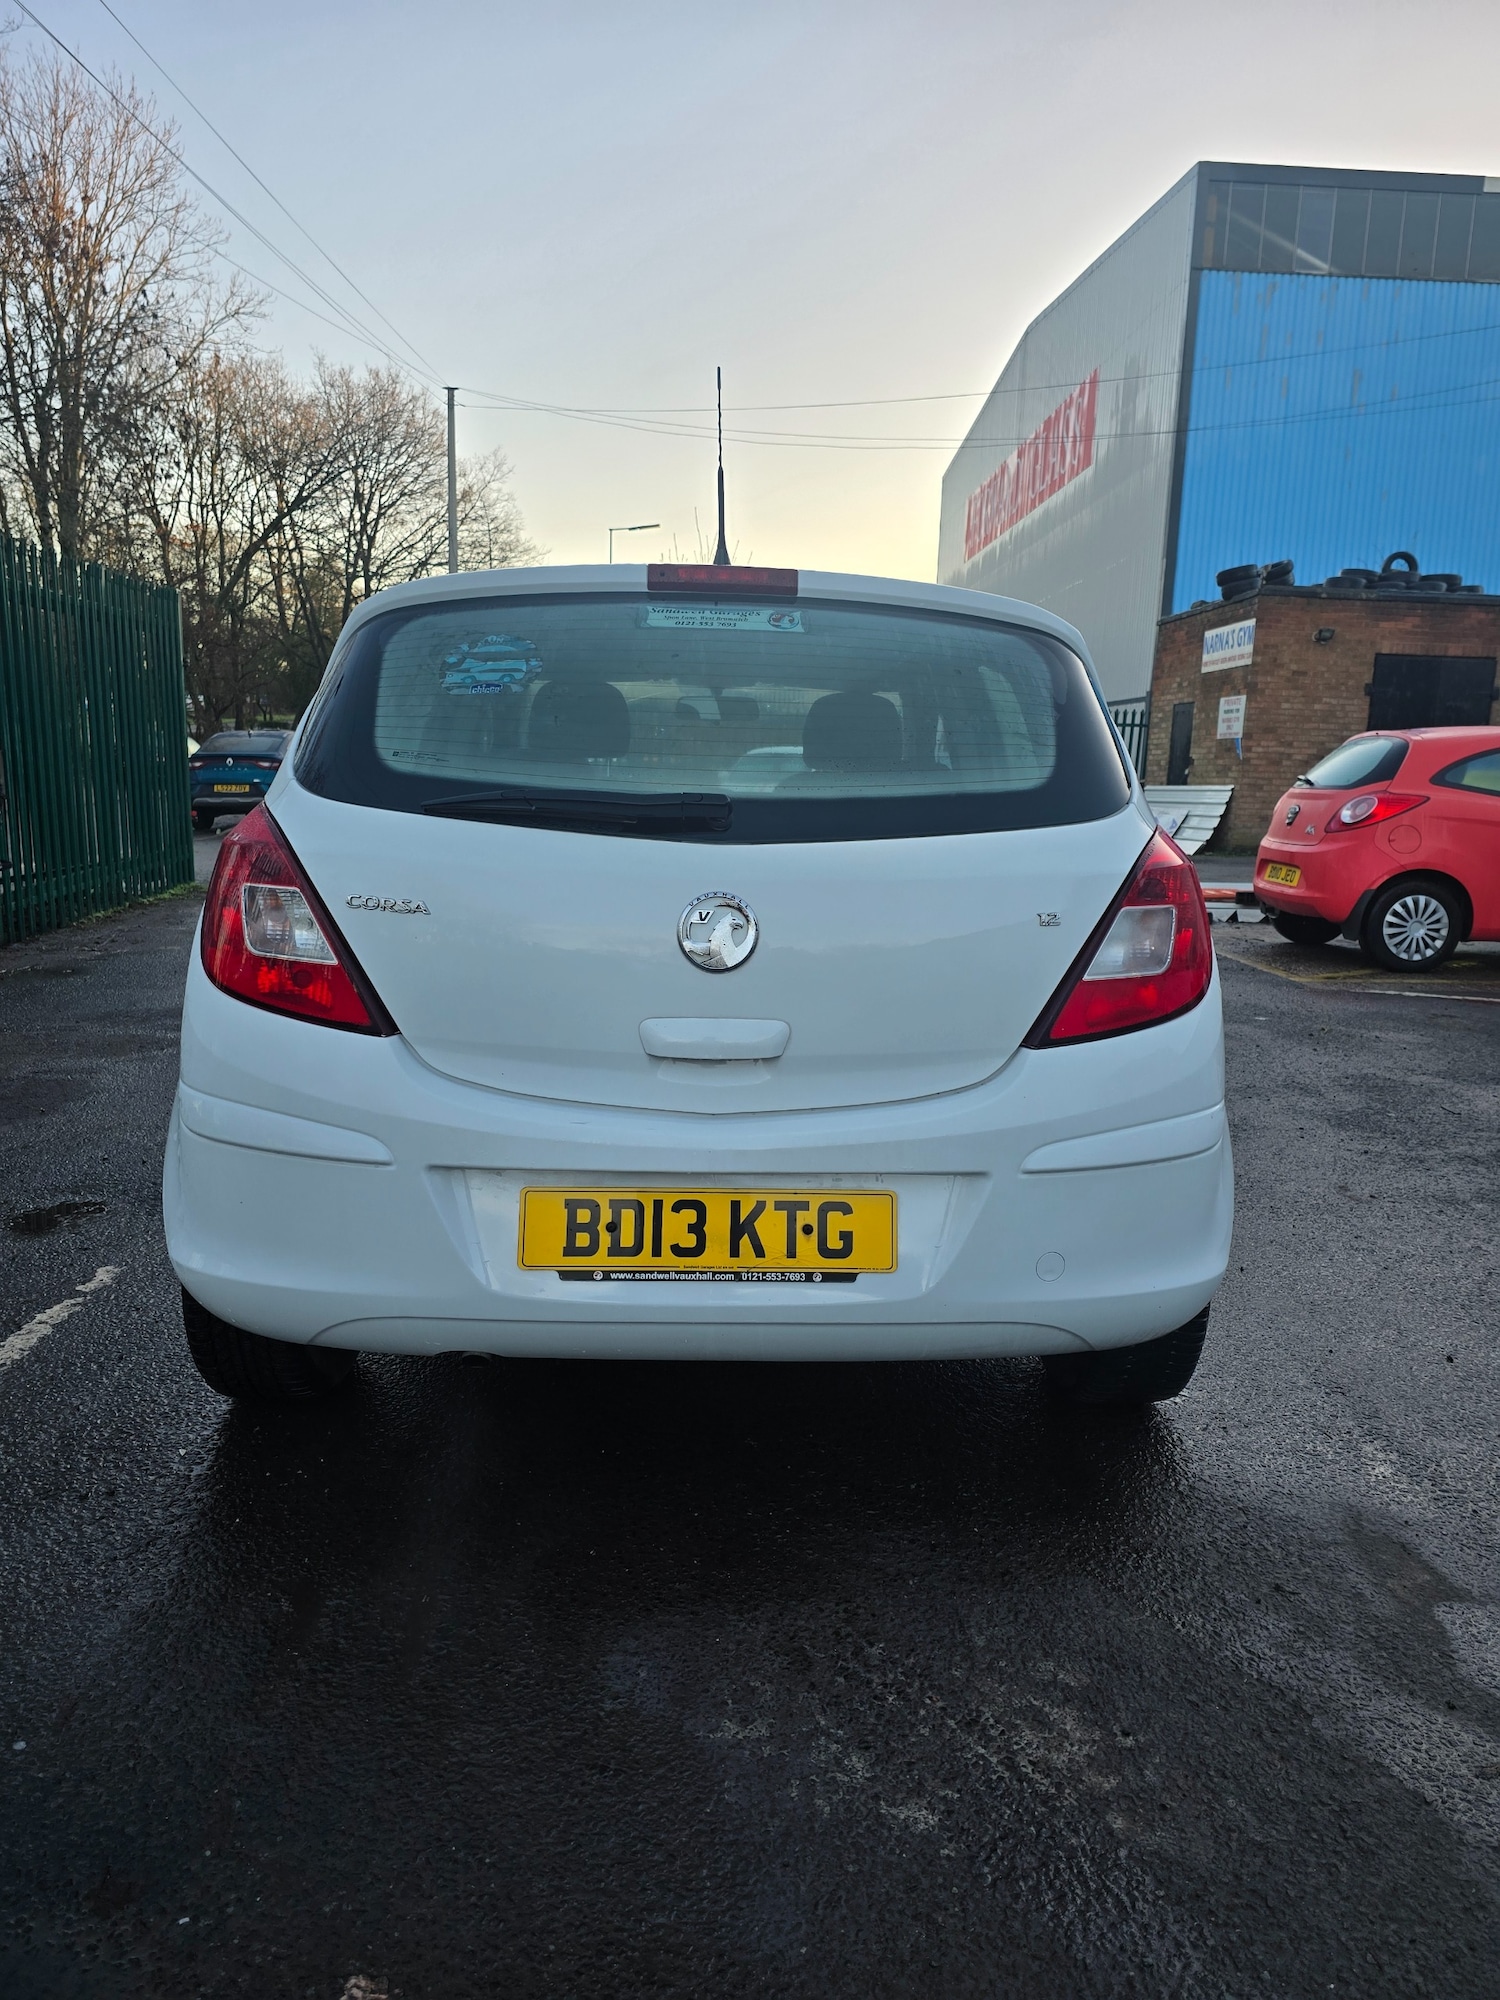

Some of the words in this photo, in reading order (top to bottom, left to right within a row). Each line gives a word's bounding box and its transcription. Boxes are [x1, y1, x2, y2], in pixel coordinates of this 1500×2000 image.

[1237, 624, 1255, 648] GYM
[472, 685, 501, 694] chicco
[345, 893, 432, 916] CORSA
[689, 891, 750, 909] VAUXHALL
[562, 1198, 707, 1257] BD13
[729, 1200, 854, 1259] KTG
[609, 1271, 735, 1281] www.sandwellvauxhall.com
[741, 1272, 806, 1282] 0121-553-7693
